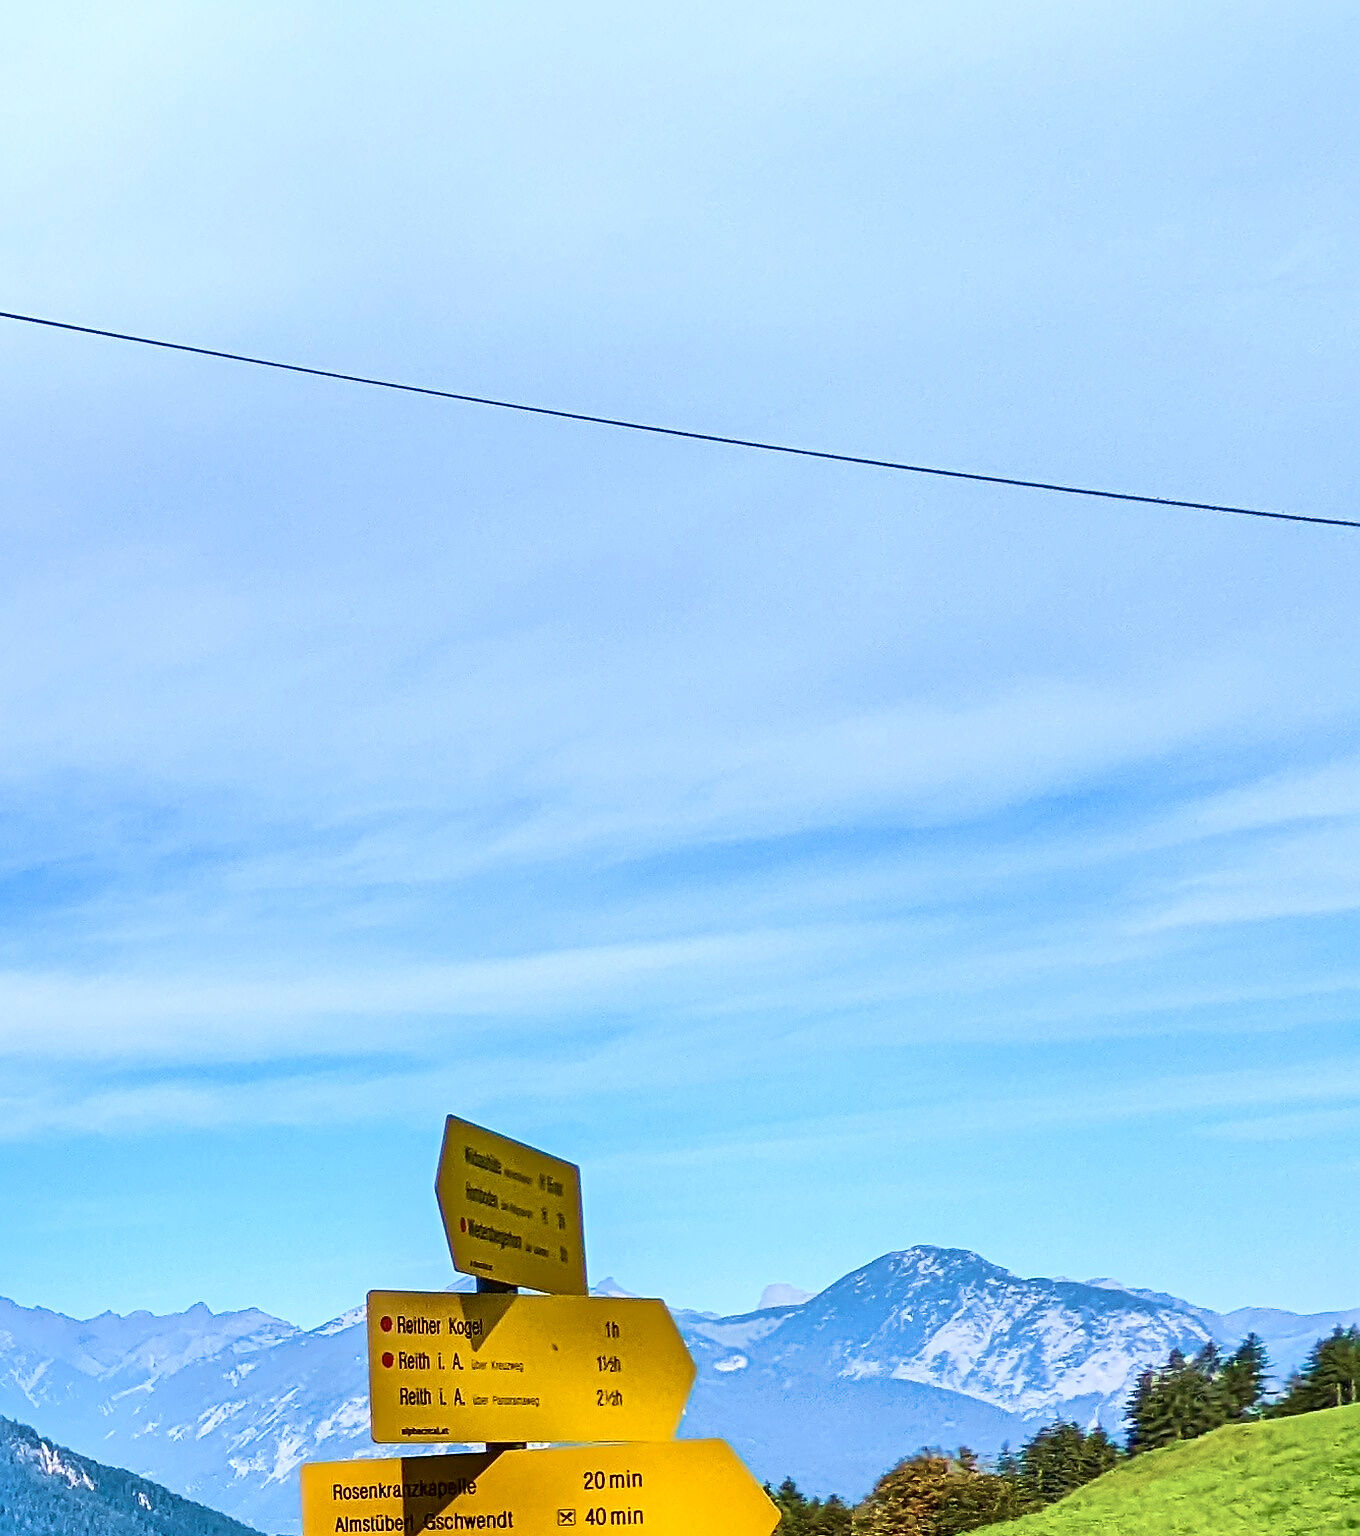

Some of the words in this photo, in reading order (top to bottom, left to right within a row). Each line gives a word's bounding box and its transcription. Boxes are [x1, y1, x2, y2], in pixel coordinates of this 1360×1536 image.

[397, 1316, 441, 1335] Reither
[448, 1317, 483, 1339] Kogel
[605, 1321, 620, 1338] 1h
[399, 1352, 430, 1370] Reith
[438, 1352, 445, 1370] i.
[452, 1352, 464, 1370] A.
[400, 1388, 431, 1406] Reith
[454, 1387, 465, 1406] A.
[333, 1478, 477, 1501] Rosenkranzkapelle
[583, 1471, 605, 1490] 20
[609, 1469, 643, 1489] min
[335, 1513, 414, 1533] Almstüberl
[424, 1511, 514, 1530] Gschwendt
[585, 1507, 607, 1526] 40
[610, 1506, 644, 1526] min
